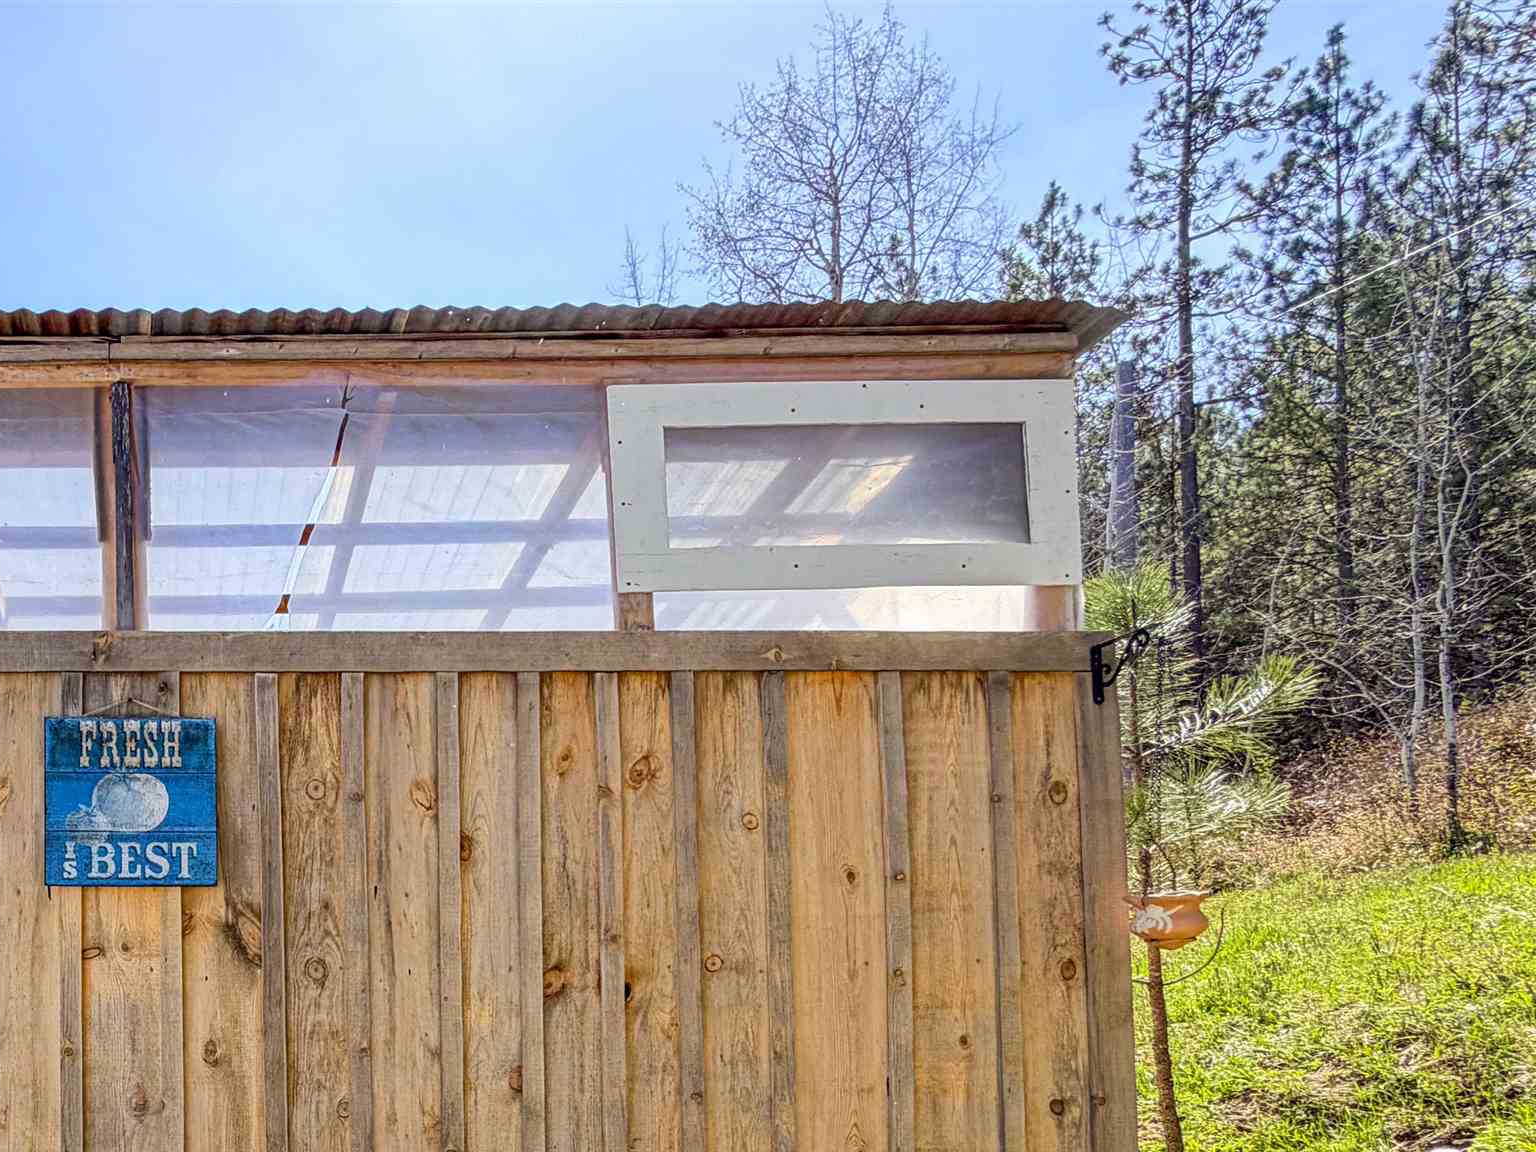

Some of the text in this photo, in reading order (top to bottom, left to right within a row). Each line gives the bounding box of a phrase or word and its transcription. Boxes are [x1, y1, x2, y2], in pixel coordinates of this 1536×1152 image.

[79, 719, 182, 768] FRESH
[63, 841, 197, 879] IS BEST
